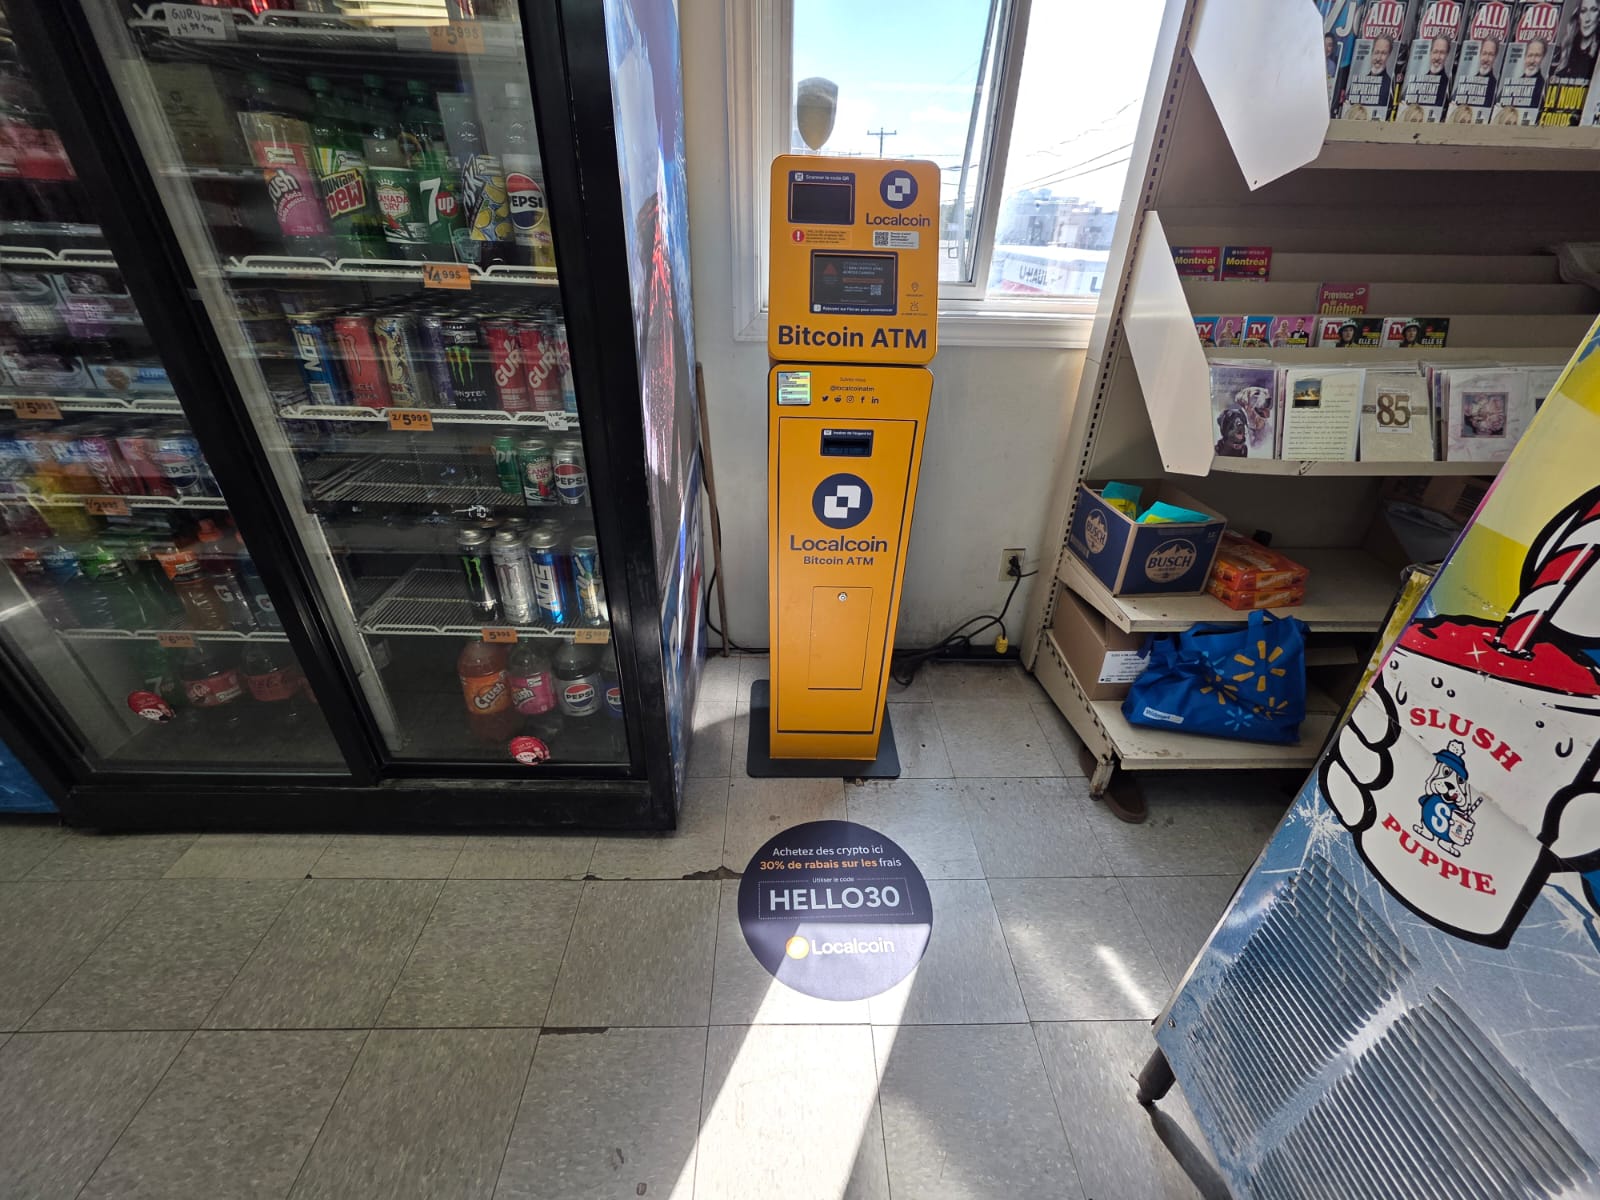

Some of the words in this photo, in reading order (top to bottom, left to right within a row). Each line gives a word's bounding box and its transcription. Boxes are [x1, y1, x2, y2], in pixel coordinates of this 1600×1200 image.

[171, 8, 200, 21] GURU
[1367, 2, 1403, 25] ALLO
[1424, 3, 1460, 26] ALLO
[1476, 5, 1509, 28] ALLO
[1521, 6, 1558, 29] ALLO
[1545, 85, 1558, 108] LA
[511, 195, 544, 209] EPSI
[866, 212, 931, 228] Localcoin
[1175, 256, 1216, 265] Montréal
[1226, 257, 1268, 266] Montréal
[1323, 291, 1354, 300] Province
[1321, 302, 1364, 315] Québec
[778, 325, 864, 347] Bitcoin
[871, 328, 927, 349] ATM
[1196, 324, 1213, 334] TV
[1251, 324, 1267, 334] TV
[1376, 393, 1411, 426] 85
[164, 465, 196, 475] EPSI
[555, 476, 586, 485] PEPSI
[1087, 520, 1105, 546] BUSCH
[790, 535, 888, 553] Localcoin
[803, 556, 843, 565] Bitcoin
[846, 557, 874, 566] ATM
[1147, 556, 1192, 569] BUSCH
[533, 563, 553, 611] NOS
[474, 682, 505, 709] Crush
[512, 687, 535, 705] rush
[566, 690, 594, 699] PEPSI
[1409, 707, 1524, 772] SLUSH
[1431, 802, 1451, 833] S
[772, 847, 814, 857] Achetez
[816, 846, 834, 856] des
[836, 846, 870, 857] crypto
[871, 845, 883, 854] ici
[1381, 812, 1497, 896] PUPPIE
[760, 861, 785, 870] 30%
[787, 861, 801, 869] de
[805, 859, 839, 869] rabais
[841, 860, 858, 868] sur
[861, 858, 878, 867] les
[879, 857, 902, 867] frais
[770, 886, 900, 911] HELLO30
[811, 937, 895, 955] Localcoin
